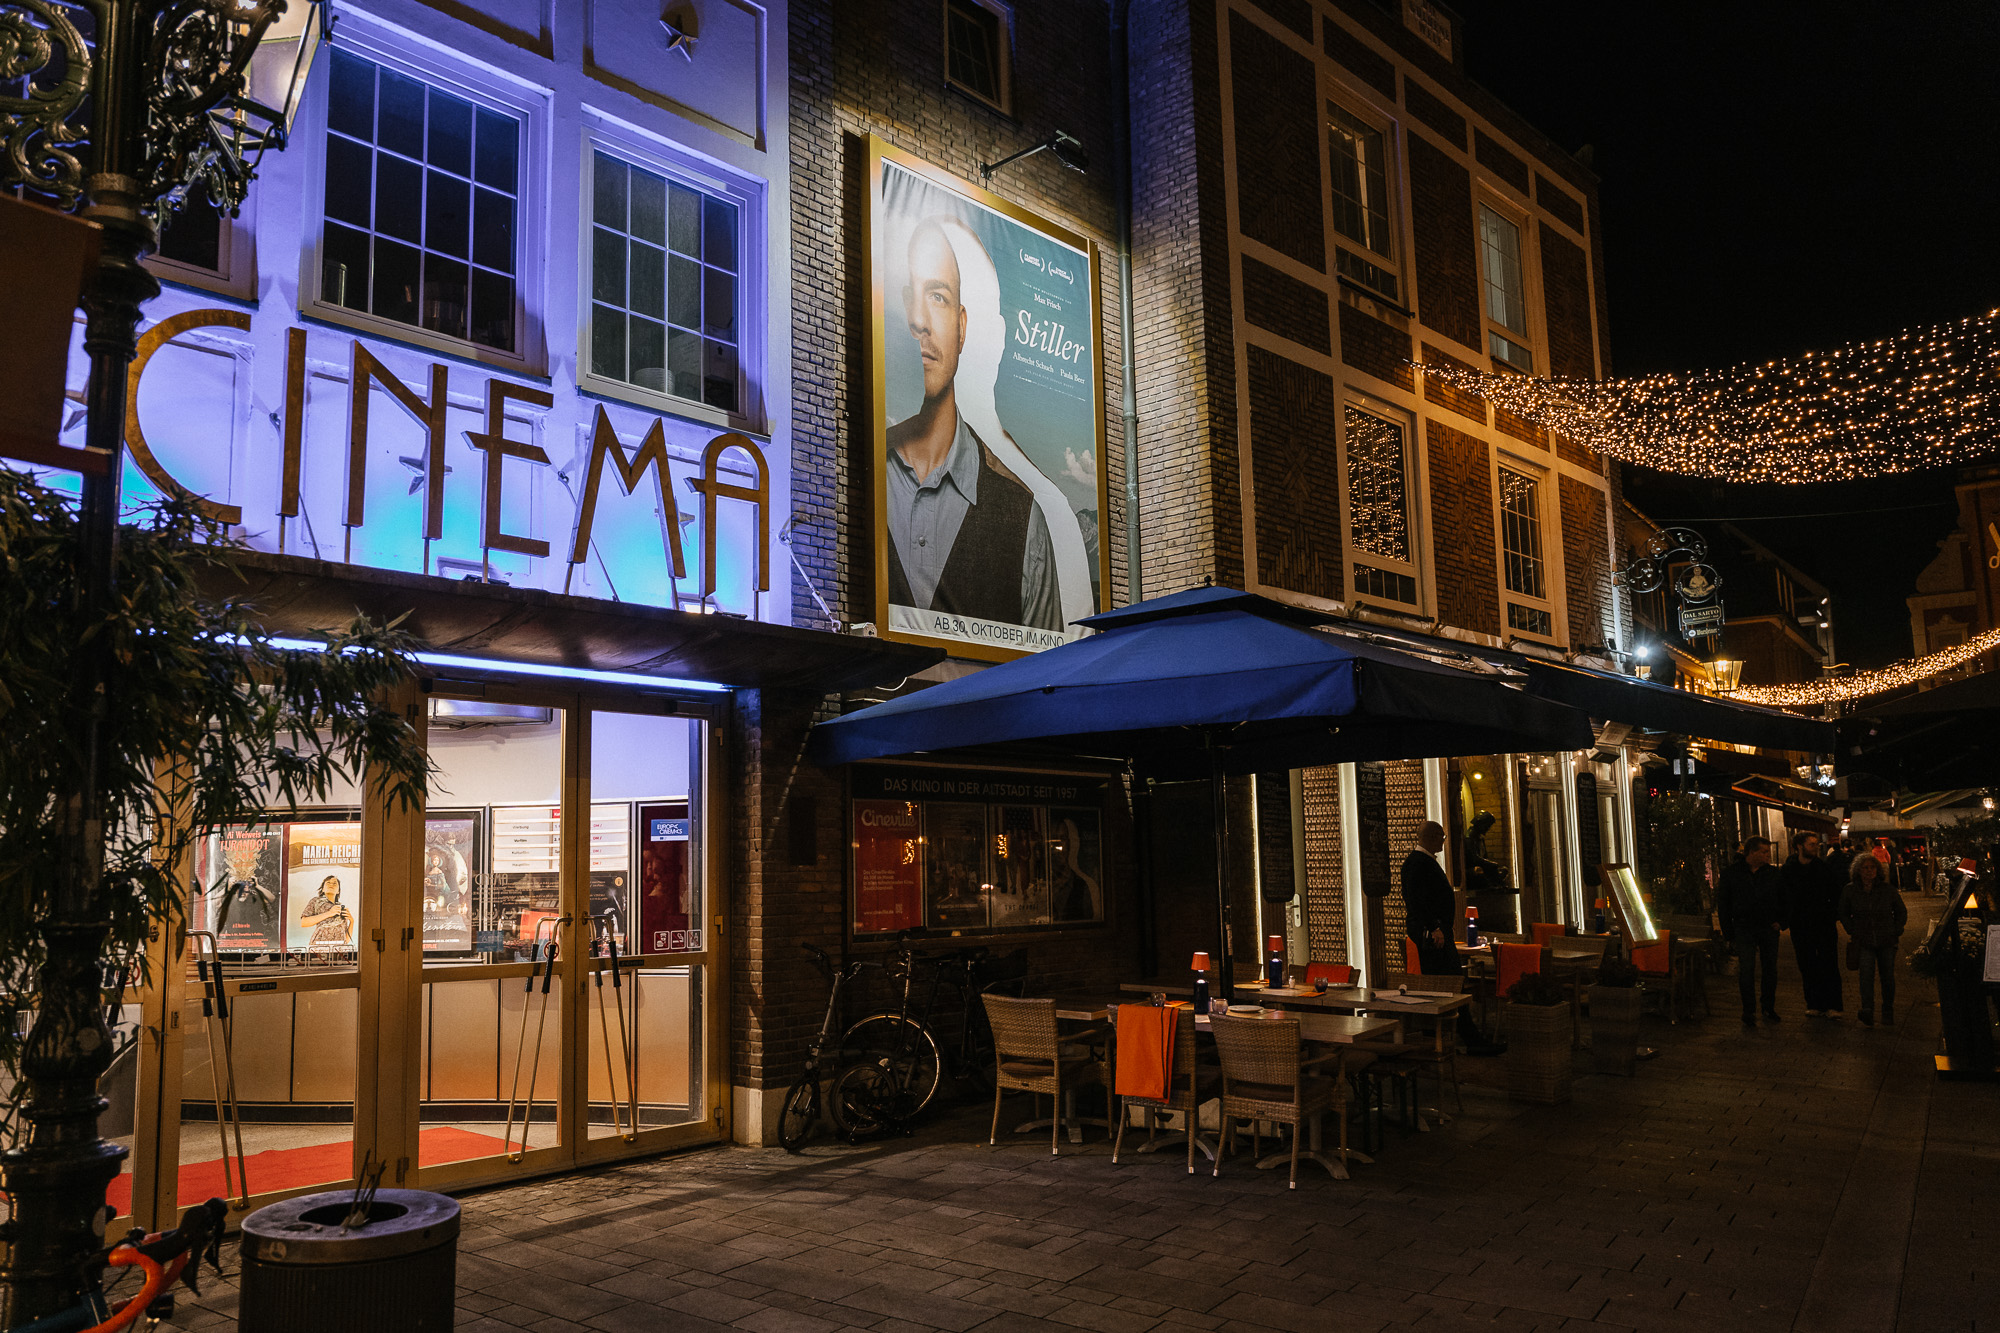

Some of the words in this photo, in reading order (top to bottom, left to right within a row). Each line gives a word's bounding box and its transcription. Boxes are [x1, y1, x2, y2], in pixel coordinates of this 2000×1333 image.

[1034, 293, 1046, 305] Max
[1046, 298, 1062, 311] Frisch
[1014, 309, 1085, 363] Stiller
[1012, 352, 1035, 366] Albrecht
[1035, 359, 1054, 373] Schuch
[1060, 368, 1073, 380] Paula
[1073, 374, 1085, 384] Beer
[124, 309, 769, 598] CINEMA
[1697, 609, 1719, 617] SARTO
[934, 616, 950, 630] AB
[952, 619, 969, 634] 30.
[971, 622, 1024, 642] OKTOBER
[1026, 631, 1038, 645] IM
[1040, 633, 1065, 648] KINO
[884, 777, 908, 792] DAS
[911, 779, 941, 793] KINO
[943, 781, 955, 794] IN
[958, 781, 980, 795] DER
[982, 783, 1032, 797] ALTSTADT
[1033, 785, 1053, 799] SEIT
[1055, 787, 1077, 800] 1957
[861, 809, 917, 827] Cineville
[219, 839, 270, 852] TURANDOT
[303, 845, 330, 859] MARIA
